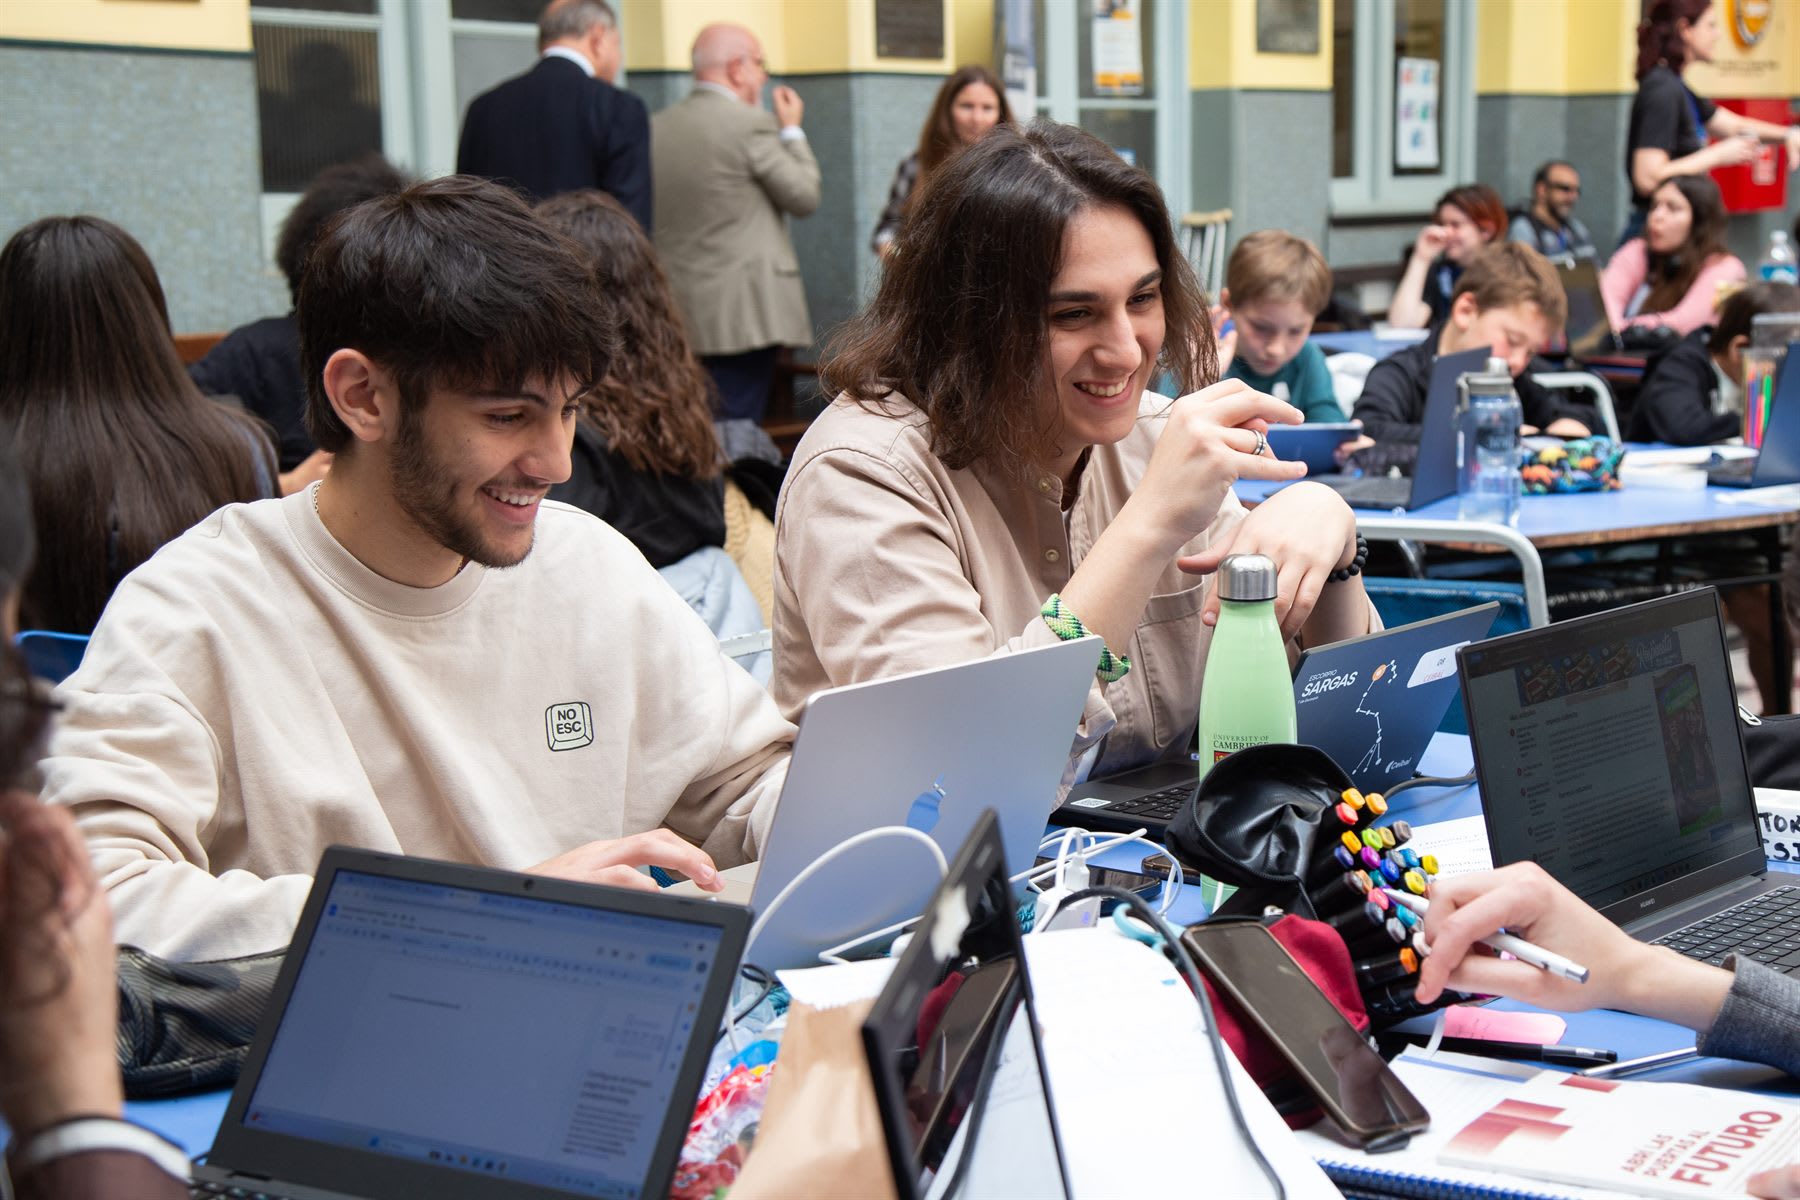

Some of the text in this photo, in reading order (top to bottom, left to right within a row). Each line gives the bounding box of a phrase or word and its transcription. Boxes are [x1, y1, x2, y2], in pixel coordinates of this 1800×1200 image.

[1309, 669, 1337, 681] ESCORPIO
[1302, 671, 1359, 698] SARGAS
[557, 709, 577, 721] NO
[556, 721, 582, 735] ESC
[1213, 733, 1270, 742] UNIVERSITY OF
[1644, 1134, 1674, 1150] LAS
[1670, 1110, 1784, 1187] FUTURO
[1642, 1130, 1711, 1178] PUERTAS AL
